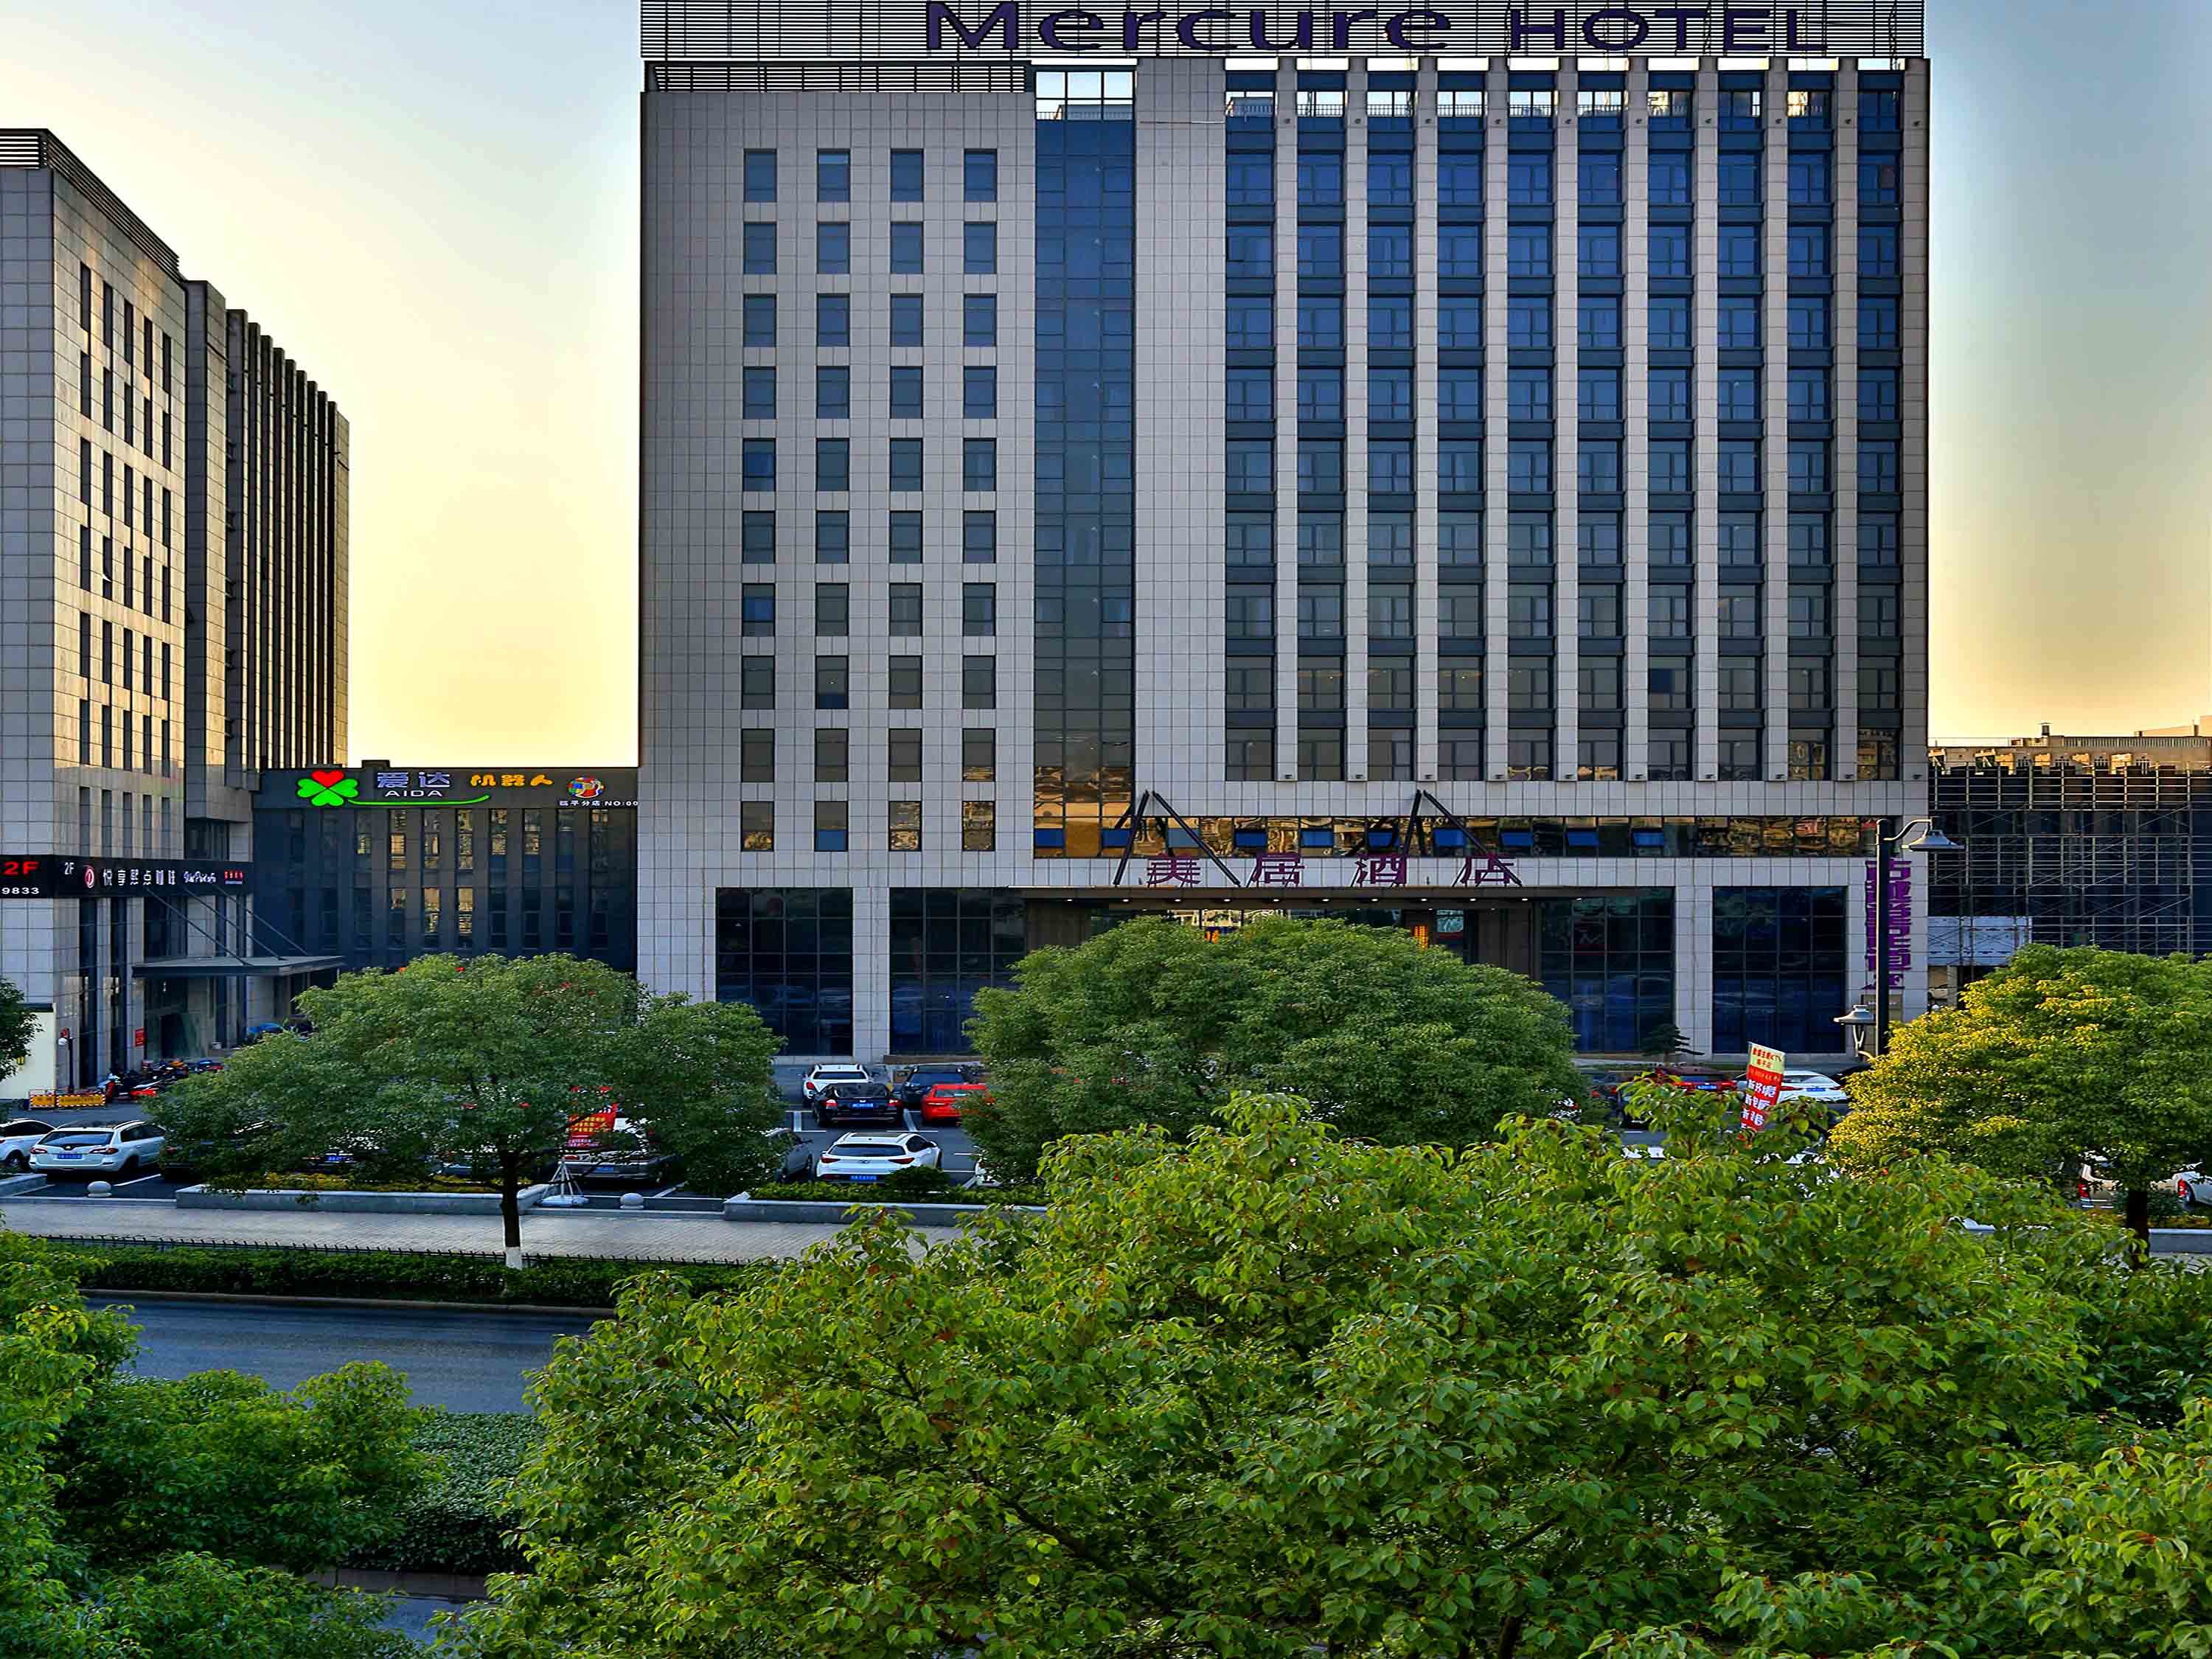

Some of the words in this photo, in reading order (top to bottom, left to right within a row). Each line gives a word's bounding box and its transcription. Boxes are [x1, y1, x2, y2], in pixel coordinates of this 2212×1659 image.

[927, 1, 1450, 51] Mercure
[1512, 10, 1828, 51] HOTEL
[377, 771, 451, 788] 爱达
[470, 774, 553, 787] 机器人
[4, 860, 39, 875] 2F
[64, 862, 75, 875] 2F
[1147, 852, 1514, 886] 美居酒店
